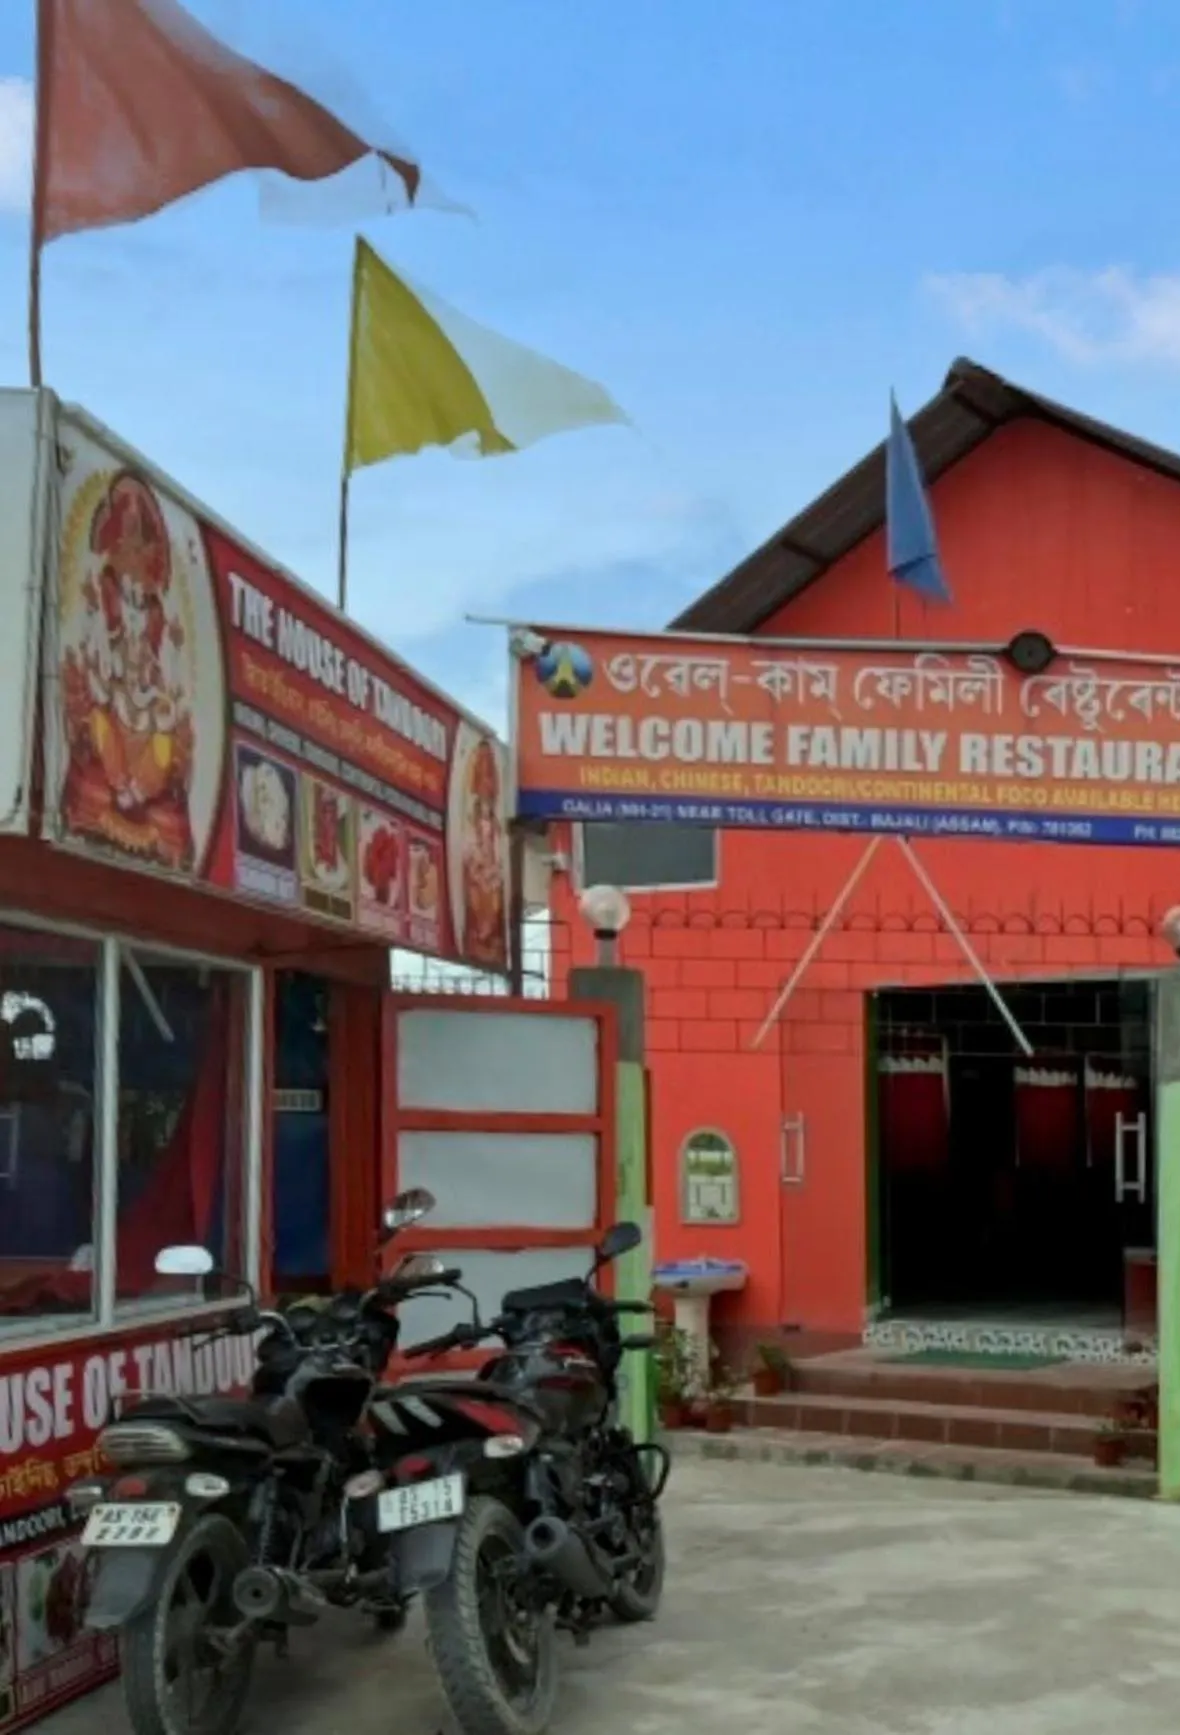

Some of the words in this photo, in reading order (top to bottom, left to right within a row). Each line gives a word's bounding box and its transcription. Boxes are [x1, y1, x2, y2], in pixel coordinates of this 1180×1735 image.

[227, 572, 273, 649] THE
[278, 607, 344, 695] HOUSE
[347, 658, 369, 711] OF
[538, 711, 775, 765] WELCOME
[787, 723, 948, 776] FAMILY
[83, 1352, 127, 1430] OF
